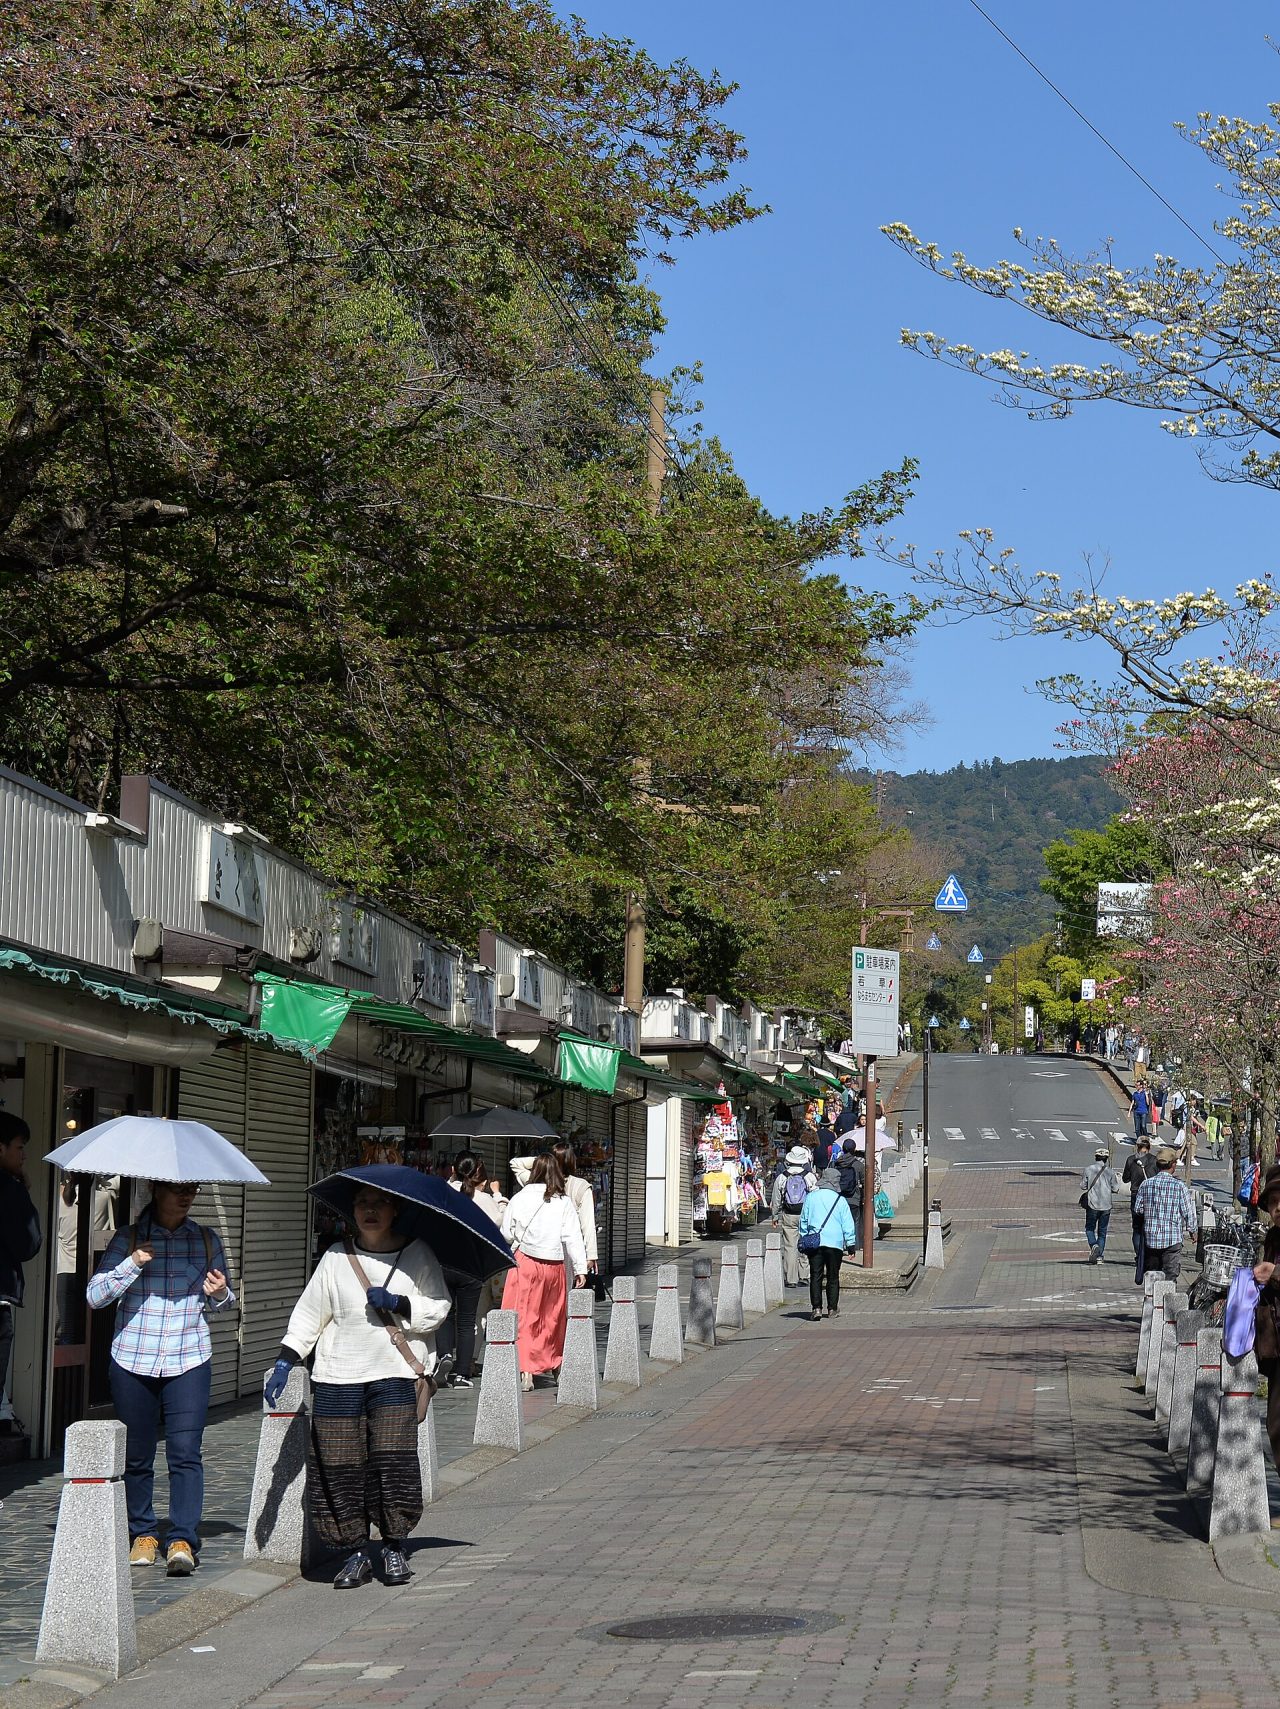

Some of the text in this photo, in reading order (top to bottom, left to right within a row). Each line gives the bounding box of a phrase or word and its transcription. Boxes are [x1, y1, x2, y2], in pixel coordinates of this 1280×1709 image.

[866, 955, 896, 971] 駐車場案内
